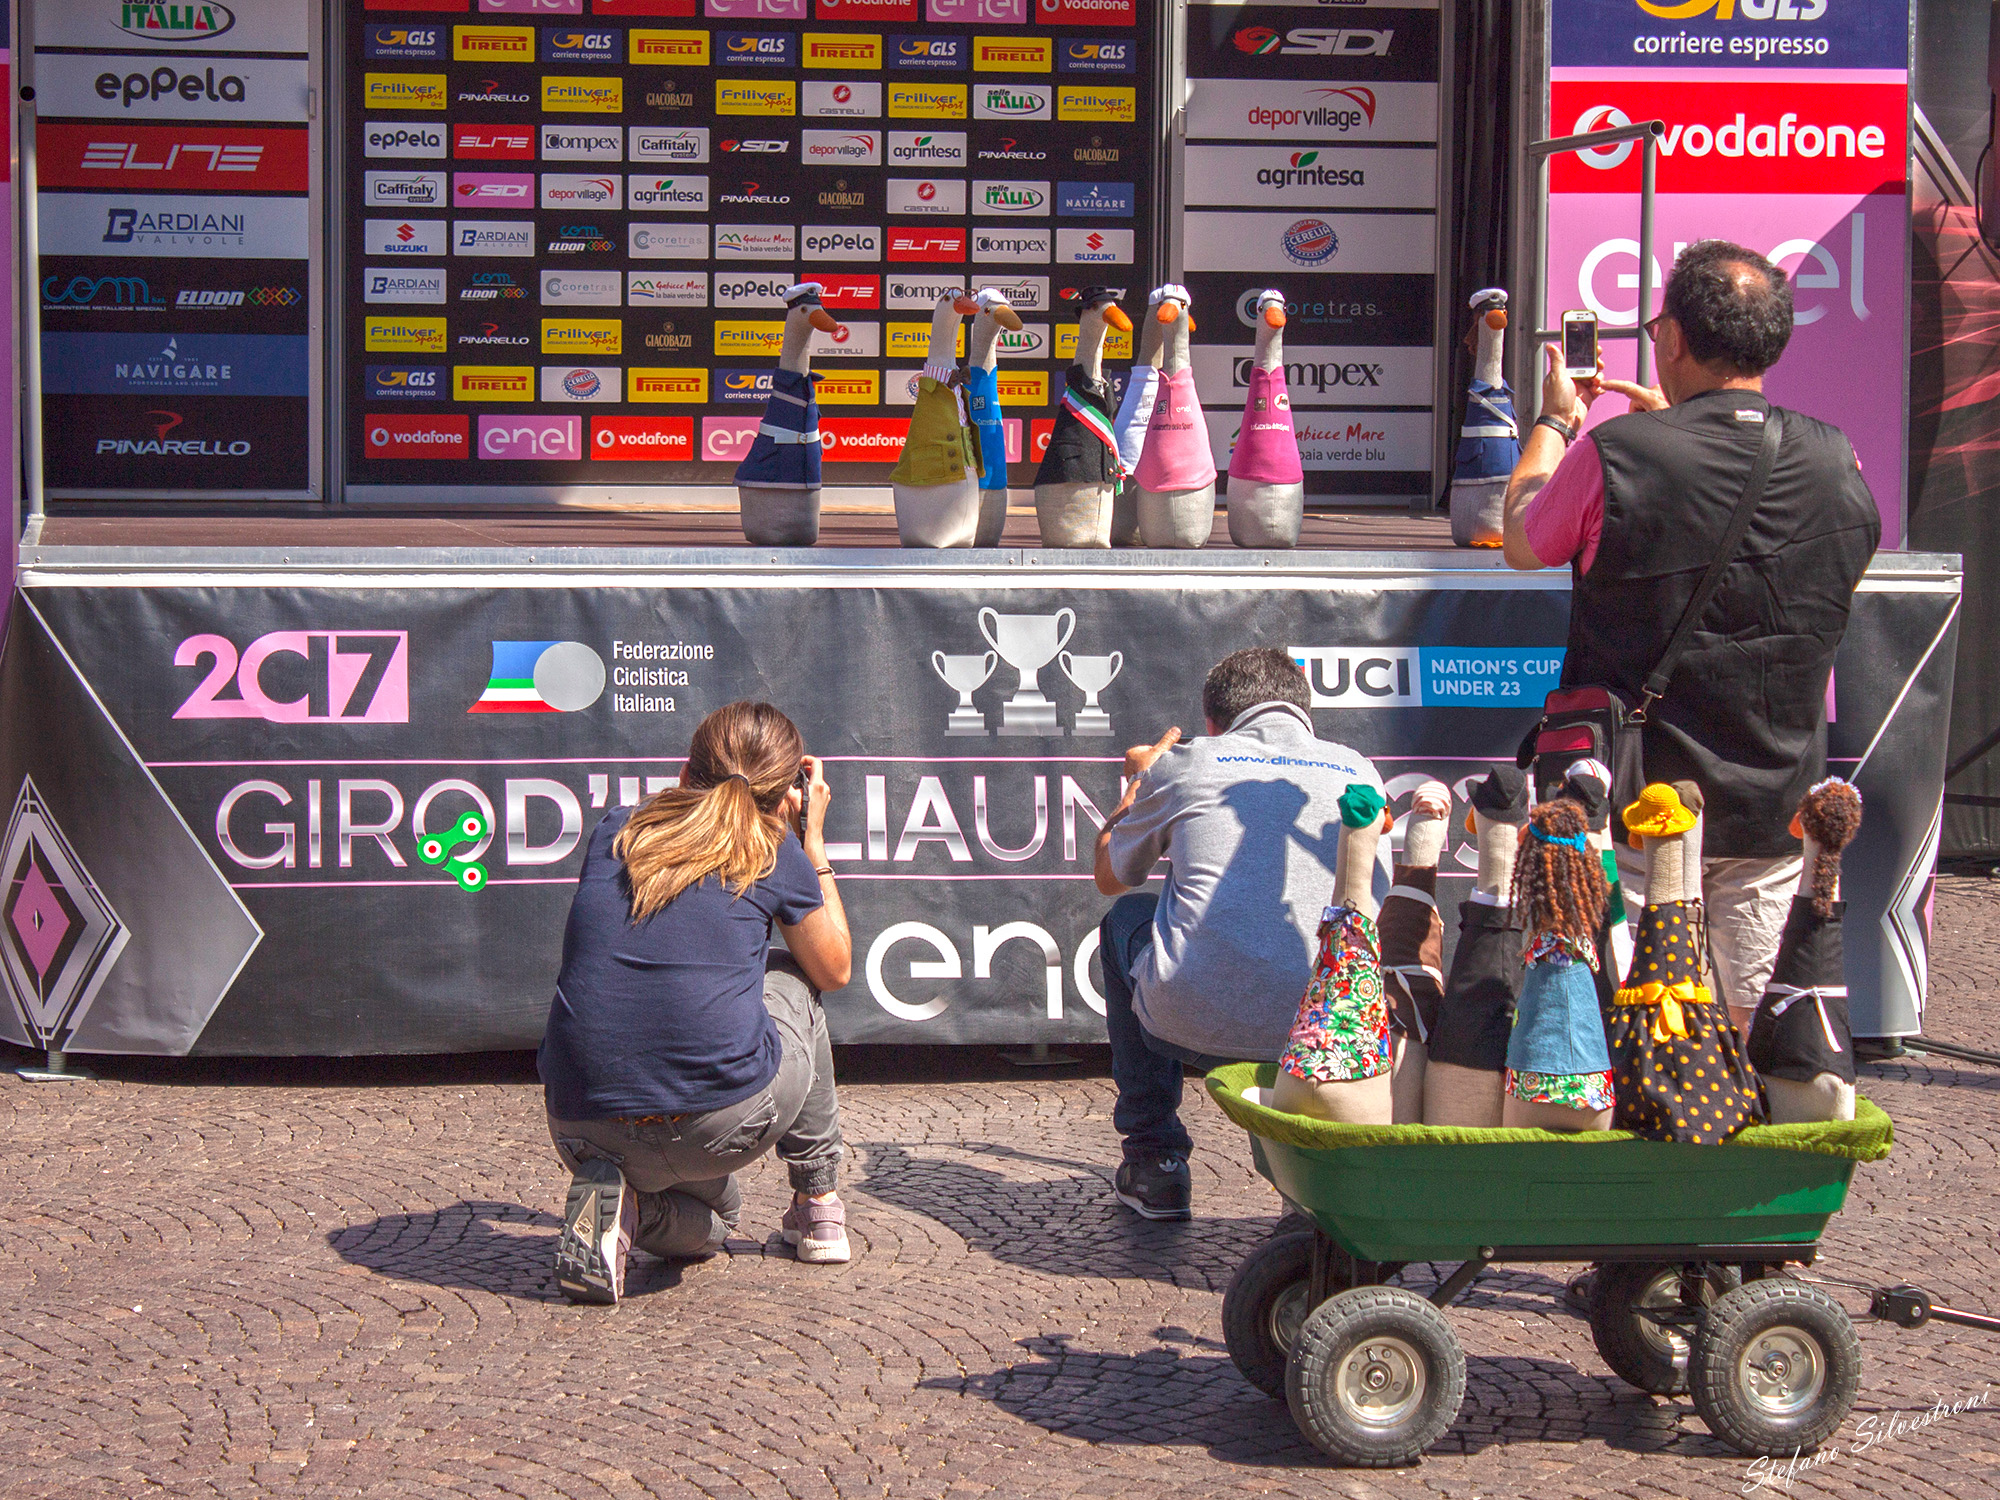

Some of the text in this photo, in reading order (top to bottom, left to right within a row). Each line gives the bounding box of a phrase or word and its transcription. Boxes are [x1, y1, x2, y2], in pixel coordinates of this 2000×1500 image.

[121, 4, 218, 31] ITALIA
[408, 31, 436, 46] GLS
[462, 35, 527, 50] PIRELLI
[584, 34, 612, 49] GLS
[758, 38, 785, 53] GLS
[1280, 28, 1394, 56] SIDI
[376, 47, 436, 57] corriere espresso
[638, 39, 702, 55] PIRELLI
[811, 43, 875, 59] PIRELLI
[930, 42, 957, 56] GLS
[1099, 45, 1126, 59] GLS
[1634, 31, 1829, 61] corriere espresso
[552, 51, 612, 60] corriere espresso
[727, 54, 785, 64] corriere espresso
[982, 46, 1045, 62] PIRELLI
[899, 57, 957, 67] corriere espresso
[1069, 61, 1126, 71] corriere espresso
[95, 67, 246, 108] eppela
[371, 83, 436, 93] Friliver
[547, 86, 612, 97] Friliver
[414, 88, 443, 102] Sport
[459, 93, 530, 103] PINARELLO
[590, 91, 619, 105] Sport
[646, 93, 693, 107] GIACOBAZZI
[721, 89, 786, 101] Friliver
[764, 94, 792, 108] Sport
[894, 92, 958, 103] Friliver
[987, 95, 1036, 109] ITALIA
[1063, 95, 1126, 106] Friliver
[936, 97, 964, 112] Sport
[1104, 100, 1132, 114] Sport
[1248, 106, 1361, 132] deporvillage
[369, 130, 440, 149] eppela
[458, 136, 529, 148] ELITE
[1655, 113, 1886, 158] vodafone
[545, 134, 617, 152] Compex
[641, 139, 697, 154] Caffitaly
[81, 142, 265, 172] ELITE
[809, 144, 866, 157] deporvillage
[893, 145, 961, 160] agrintesa
[978, 151, 1046, 160] PINARELLO
[1074, 148, 1119, 161] GIACOBAZZI
[1257, 165, 1365, 189] agrintesa
[377, 183, 435, 197] Caffitaly
[549, 188, 607, 202] deporvillage
[986, 184, 1009, 192] selle
[634, 188, 703, 204] agrintesa
[720, 195, 790, 204] PINARELLO
[819, 192, 864, 206] GIACOBAZZI
[986, 192, 1035, 205] ITALIA
[1066, 199, 1126, 208] NAVIGARE
[102, 207, 245, 243] BARDIANI
[137, 235, 244, 246] VALVOLE
[460, 229, 529, 246] BARDIANI
[774, 233, 793, 243] Mare
[1289, 226, 1331, 245] CERELIA
[384, 244, 428, 253] SUZUKI
[548, 242, 586, 251] ELDON
[750, 244, 764, 252] baia
[765, 245, 781, 253] verde
[782, 245, 793, 253] blu
[806, 233, 874, 253] eppela
[893, 239, 960, 251] ELITE
[976, 237, 1046, 254] Compex
[1074, 253, 1116, 261] SUZUKI
[371, 276, 440, 294] BARDIANI
[686, 281, 706, 291] Mare
[175, 290, 246, 306] ELDON
[460, 289, 499, 299] ELDON
[677, 292, 694, 300] verde
[695, 292, 706, 300] blu
[1286, 301, 1377, 316] oretras
[371, 326, 436, 337] Friliver
[414, 331, 444, 345] Sport
[547, 329, 612, 339] Friliver
[459, 336, 530, 345] PINARELLO
[590, 333, 619, 347] Sport
[645, 334, 692, 347] GIACOBAZZI
[116, 364, 232, 379] NAVIGARE
[1233, 357, 1380, 394] Cmpex
[408, 372, 436, 386] GLS
[462, 375, 527, 390] PIRELLI
[636, 377, 701, 392] PIRELLI
[756, 375, 774, 389] GL
[376, 388, 436, 398] corriere espresso
[725, 392, 752, 400] corriere
[394, 430, 463, 444] vodafone
[484, 420, 574, 455] enel
[619, 433, 687, 445] vodafone
[840, 433, 907, 446] vodafone
[1346, 422, 1385, 443] Mare
[1327, 449, 1385, 461] verde blu
[612, 640, 714, 660] Federazione
[1431, 659, 1561, 675] NATION'S CUP
[613, 666, 689, 687] Ciclistica
[1312, 657, 1411, 697] UCI
[1433, 680, 1521, 696] UNDER 23
[614, 693, 675, 713] Italiana
[1216, 755, 1358, 776] www.dinenno.it
[811, 1209, 836, 1220] NIKE
